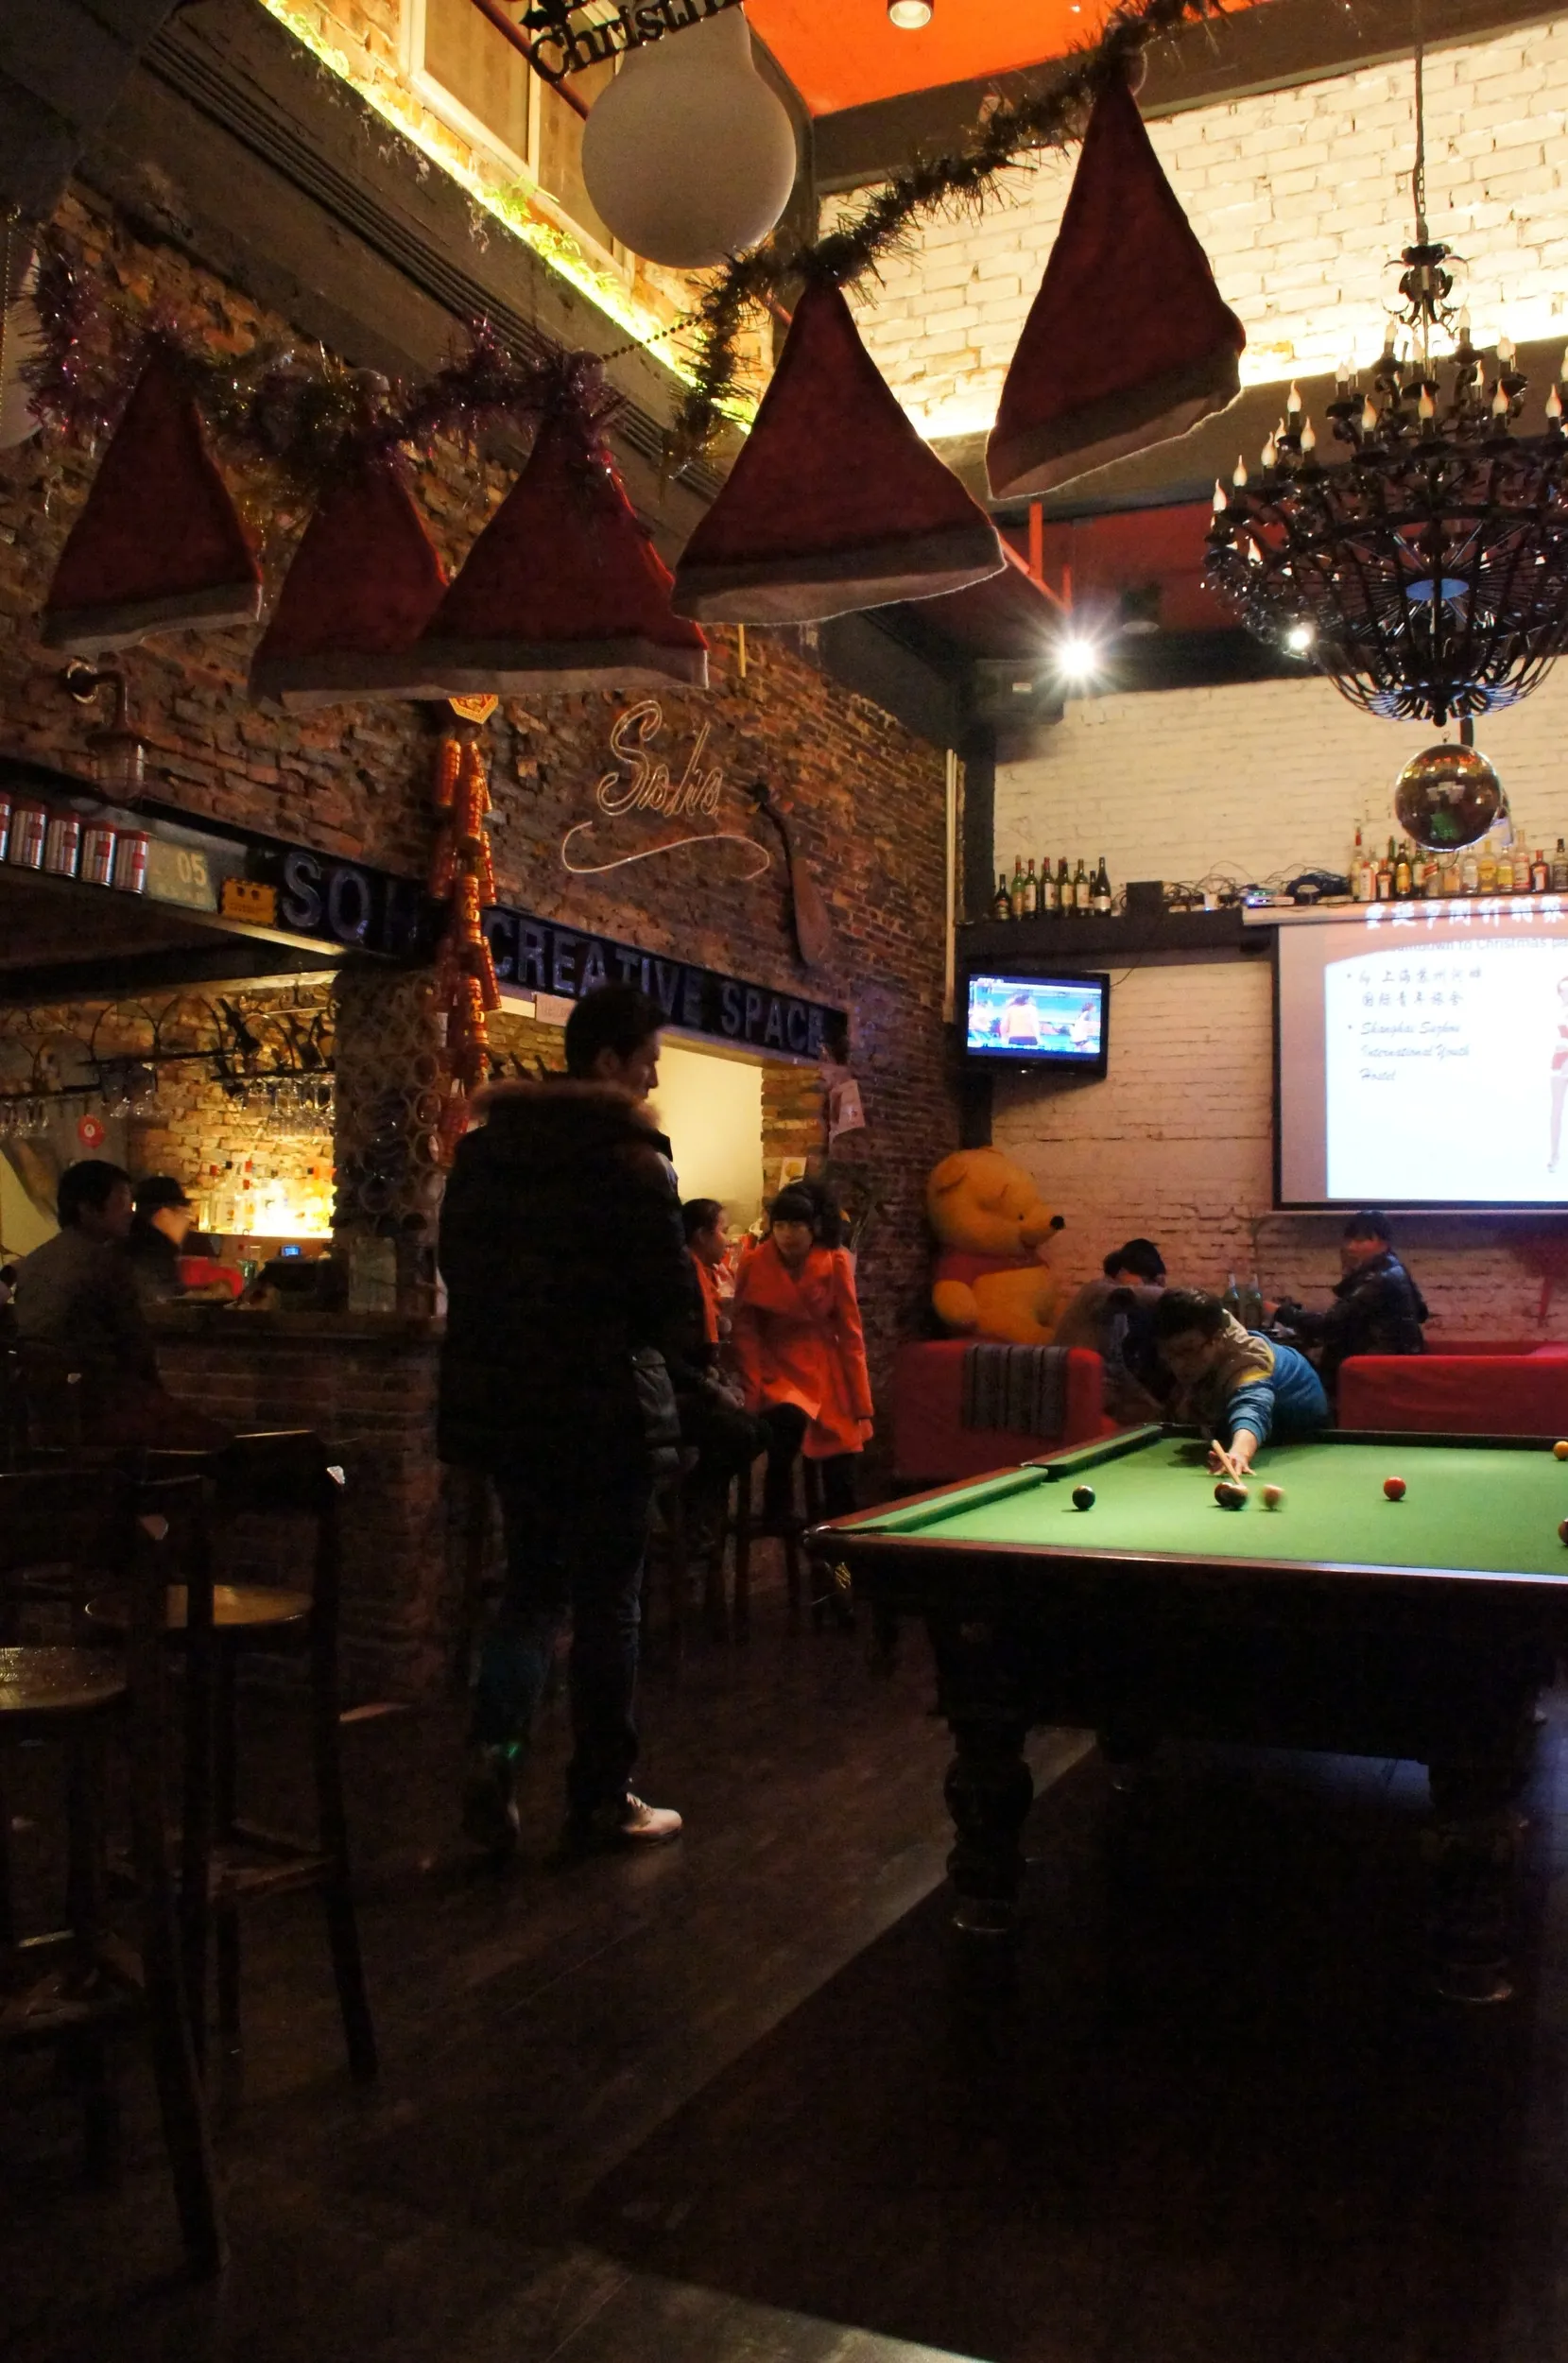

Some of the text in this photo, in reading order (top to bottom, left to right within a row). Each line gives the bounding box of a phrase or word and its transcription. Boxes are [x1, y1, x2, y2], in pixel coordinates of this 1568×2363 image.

[596, 699, 722, 817] Soho
[483, 910, 703, 1027] CREATIVE
[720, 980, 824, 1053] SPACE
